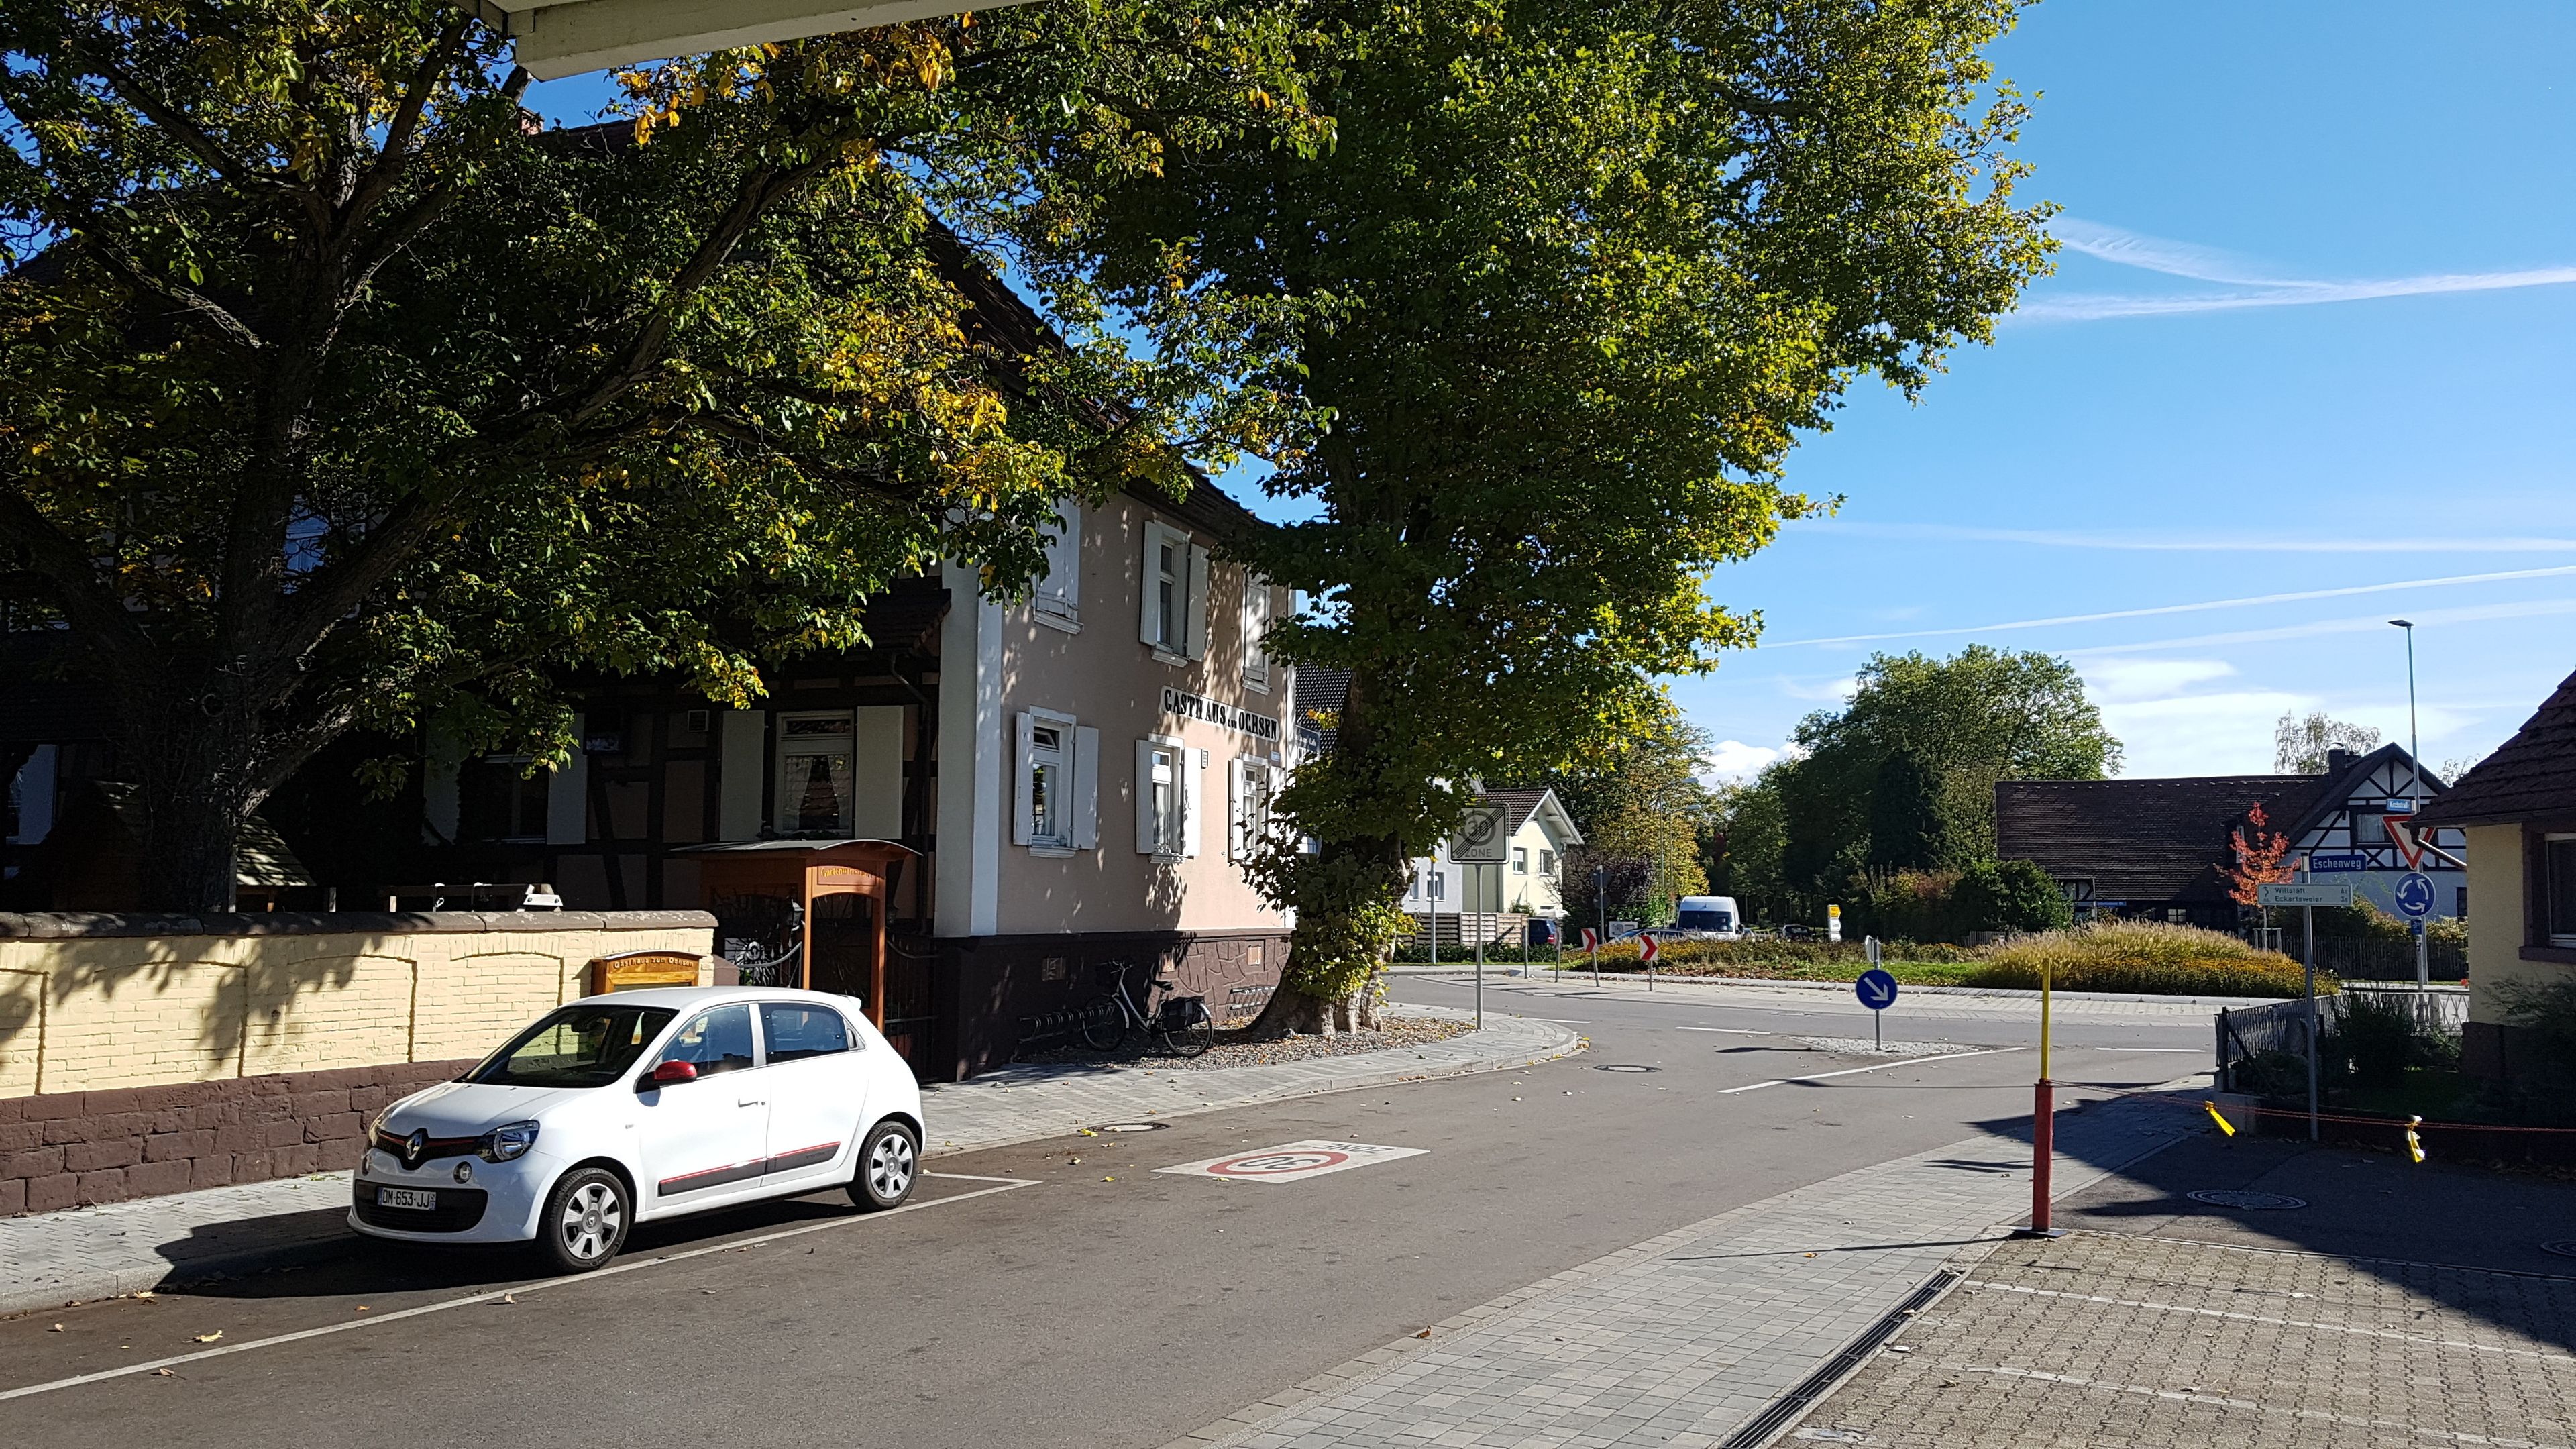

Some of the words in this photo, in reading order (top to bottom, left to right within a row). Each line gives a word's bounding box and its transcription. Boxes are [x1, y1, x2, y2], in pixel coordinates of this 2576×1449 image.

[1164, 689, 1226, 725] GASTHAUS
[1238, 711, 1277, 739] OCHSEN
[1468, 820, 1489, 837] 30
[1464, 848, 1492, 857] ZONE
[2312, 858, 2361, 870] Eschenweg
[614, 957, 649, 969] Gasthaus
[668, 957, 694, 967] Ochsen
[1313, 1143, 1395, 1153] ZONE
[1237, 1156, 1321, 1170] 30
